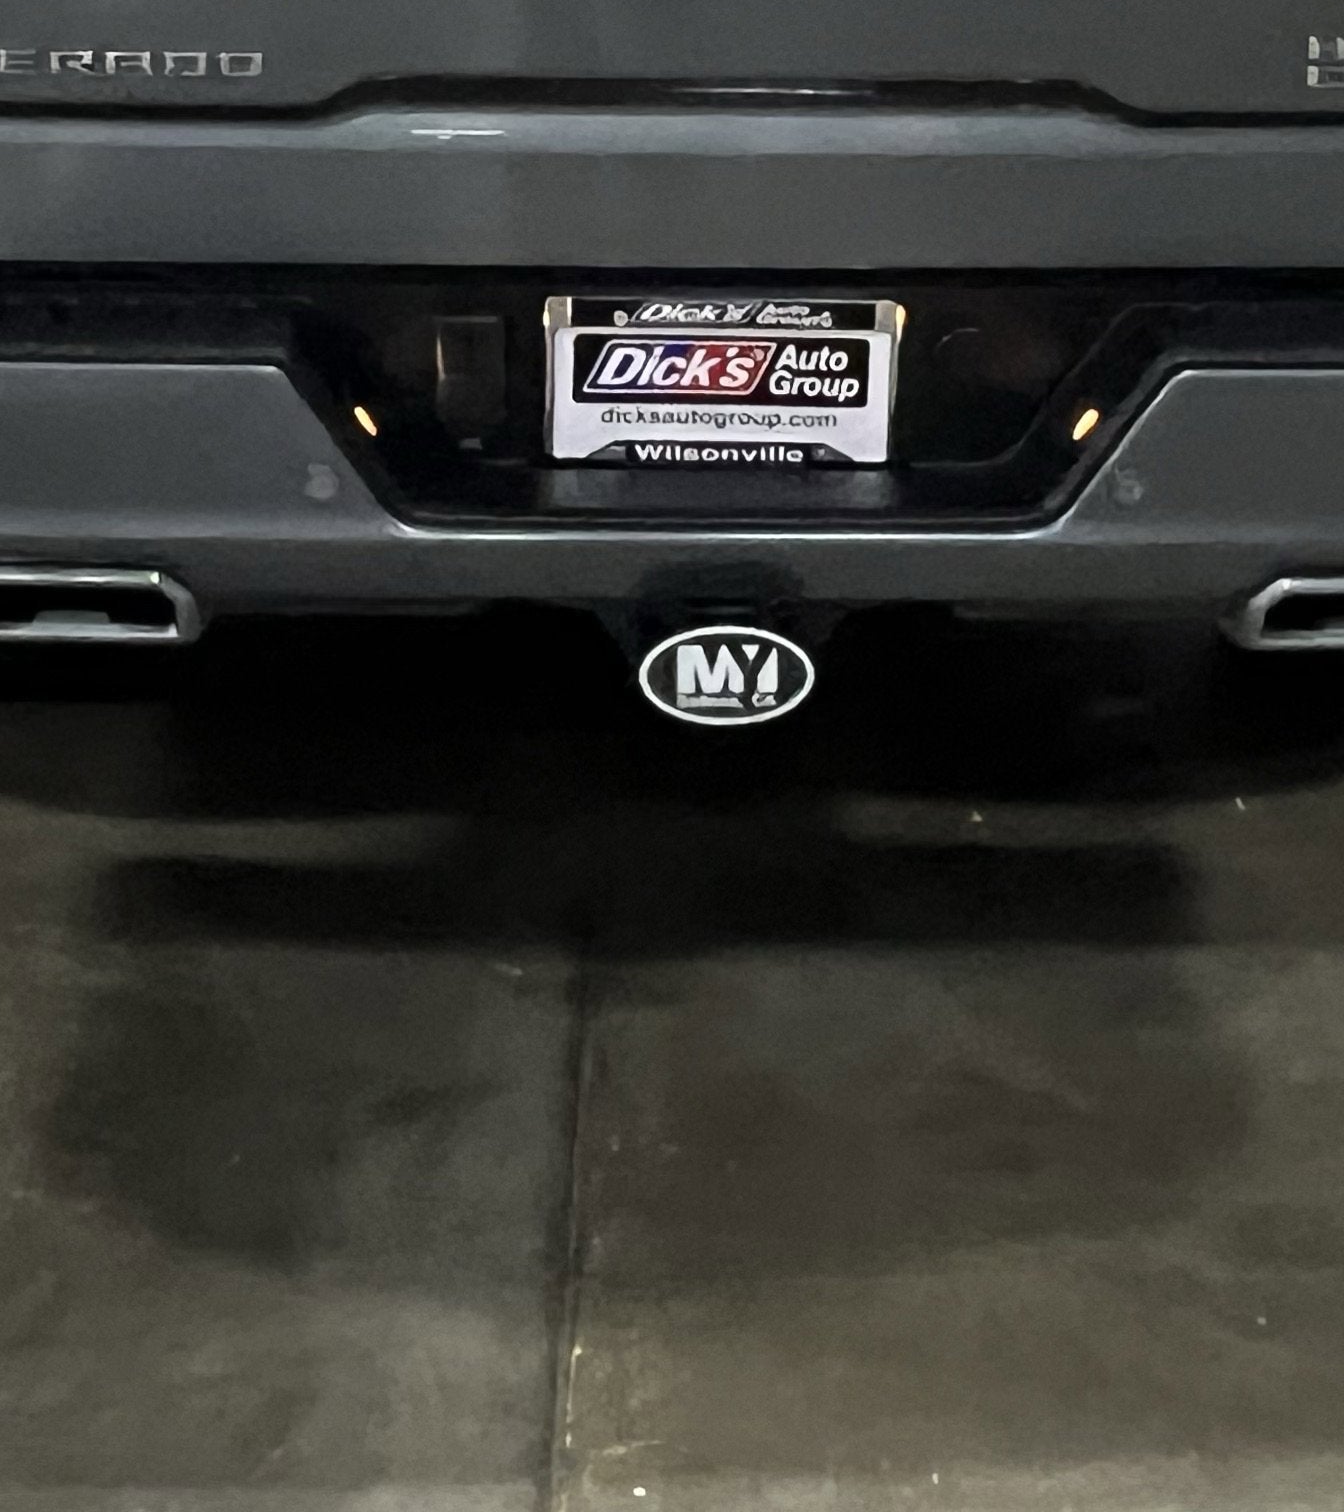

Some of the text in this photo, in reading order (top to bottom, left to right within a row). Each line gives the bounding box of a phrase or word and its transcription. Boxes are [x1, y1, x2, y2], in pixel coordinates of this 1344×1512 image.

[597, 346, 755, 388] Dick's
[775, 344, 849, 371] Auto
[768, 370, 860, 402] Group
[635, 443, 804, 463] Wilsonville
